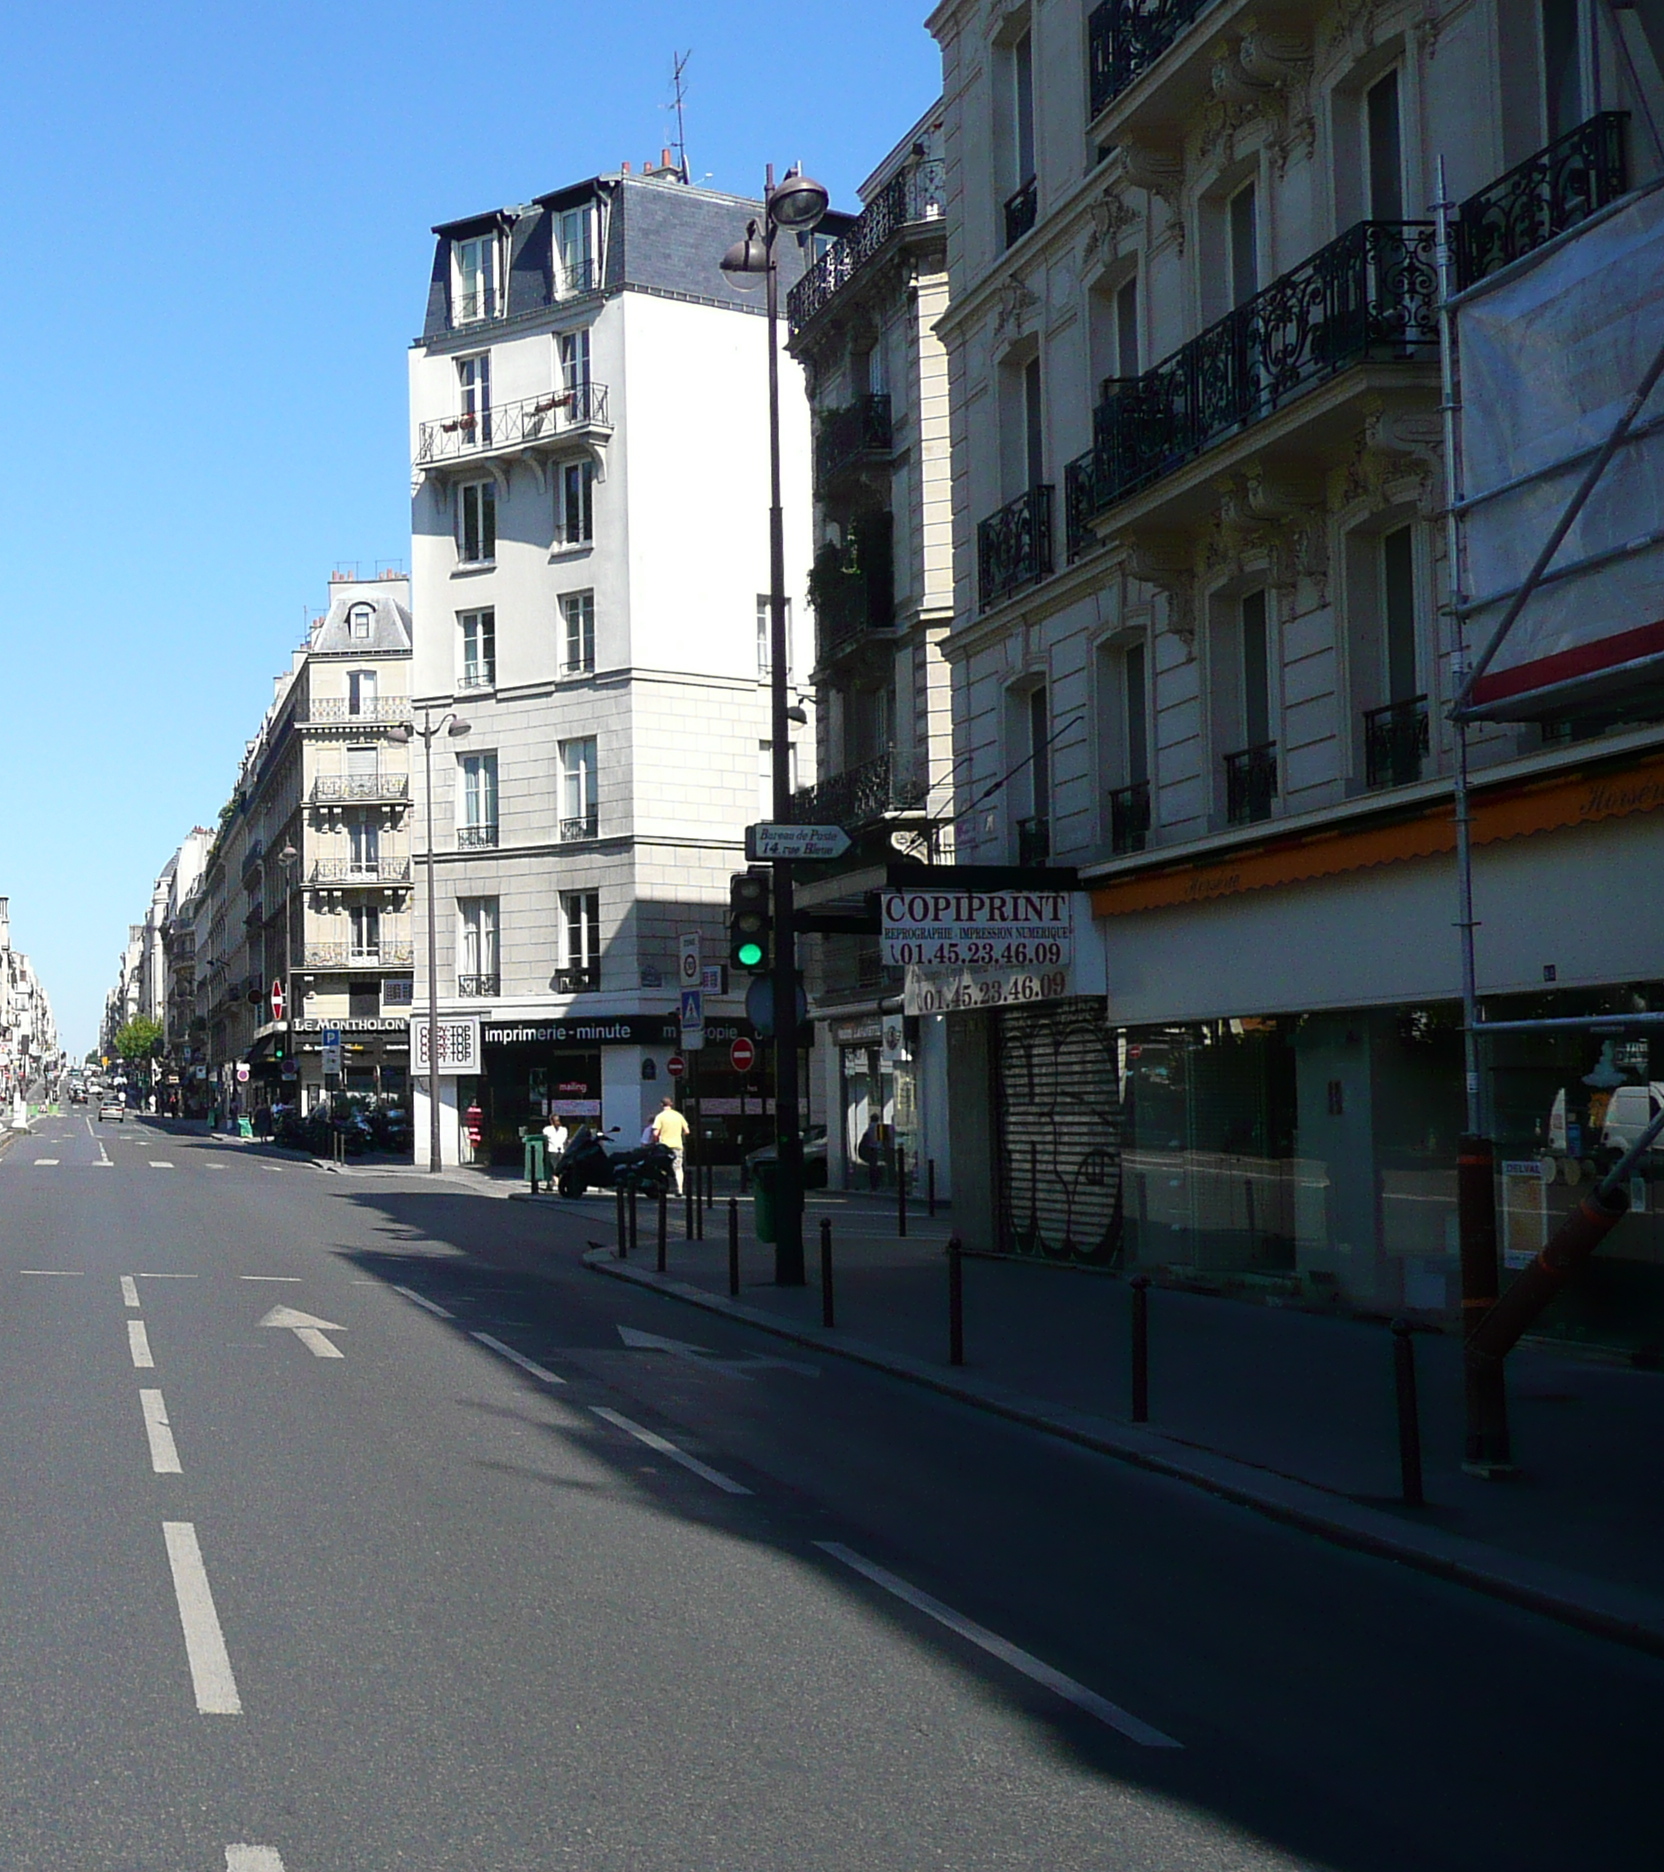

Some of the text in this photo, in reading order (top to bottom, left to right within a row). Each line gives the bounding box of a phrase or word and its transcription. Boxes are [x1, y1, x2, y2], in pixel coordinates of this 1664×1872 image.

[761, 828, 838, 841] Bureau de Poste
[783, 845, 800, 854] rue
[885, 895, 1066, 922] COPIPRINT
[884, 926, 1068, 941] REPROGRAPHIE IMPRESSION NUMERIQUE
[900, 942, 1061, 965] 01.45.23.46.09
[924, 971, 1066, 1011] 01.45.23.46.09
[293, 1018, 405, 1031] LE MONTHOLON
[420, 1026, 471, 1036] CPY-TOP
[420, 1052, 471, 1063] CPY-TOP
[1506, 1163, 1541, 1174] DELVAL
